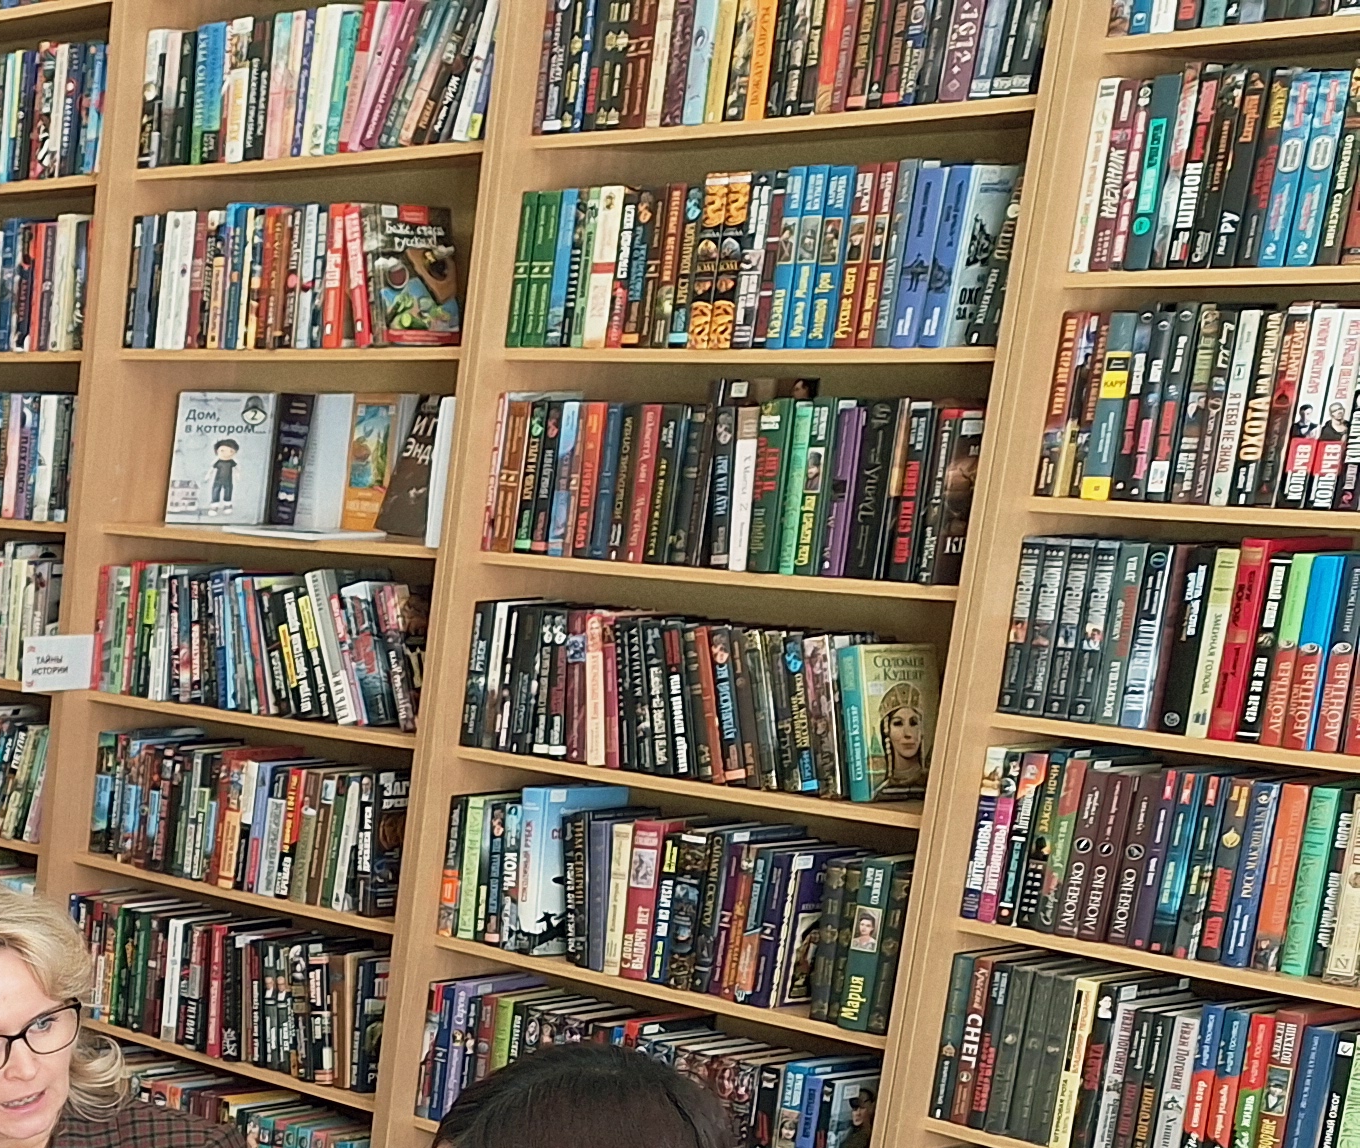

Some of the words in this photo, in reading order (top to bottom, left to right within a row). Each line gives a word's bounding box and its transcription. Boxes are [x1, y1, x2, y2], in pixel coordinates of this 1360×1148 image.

[1175, 162, 1203, 229] ШПИОН
[1258, 312, 1281, 375] МАРШАЛА
[1254, 377, 1270, 394] НА
[185, 408, 220, 423] Дом,
[1222, 430, 1234, 442] НЕ
[1225, 402, 1239, 426] ТЕБЯ
[1238, 395, 1270, 461] ОХОТА
[1286, 444, 1312, 500] КОЛЫЧЕВ
[1312, 444, 1342, 508] КОЛЫЧЕВ
[1207, 613, 1223, 657] ЗМЕИНАЯ
[1200, 659, 1214, 695] ГОЛОВА
[1269, 661, 1292, 733] ЛЕОНТЬЕВ
[1294, 663, 1317, 741] ЛЕОНТЬЕВ
[1325, 662, 1349, 739] ЛЕОНТЬЕВ
[1039, 797, 1053, 832] ЗАКОН
[1047, 764, 1060, 794] НОЧИ
[637, 905, 650, 925] НЕТ
[1062, 862, 1085, 925] ЛЮБЕНКО
[1083, 866, 1107, 930] ЛЮБЕНКО
[1114, 869, 1136, 933] ЛЮБЕНКО
[632, 928, 649, 970] ВЫДАЧИ
[840, 975, 866, 1021] Мария
[962, 1014, 982, 1068] СНЕГ
[1273, 1022, 1285, 1060] АЛЕКСЕЙ
[1281, 1023, 1297, 1064] ПОТЕХИН
